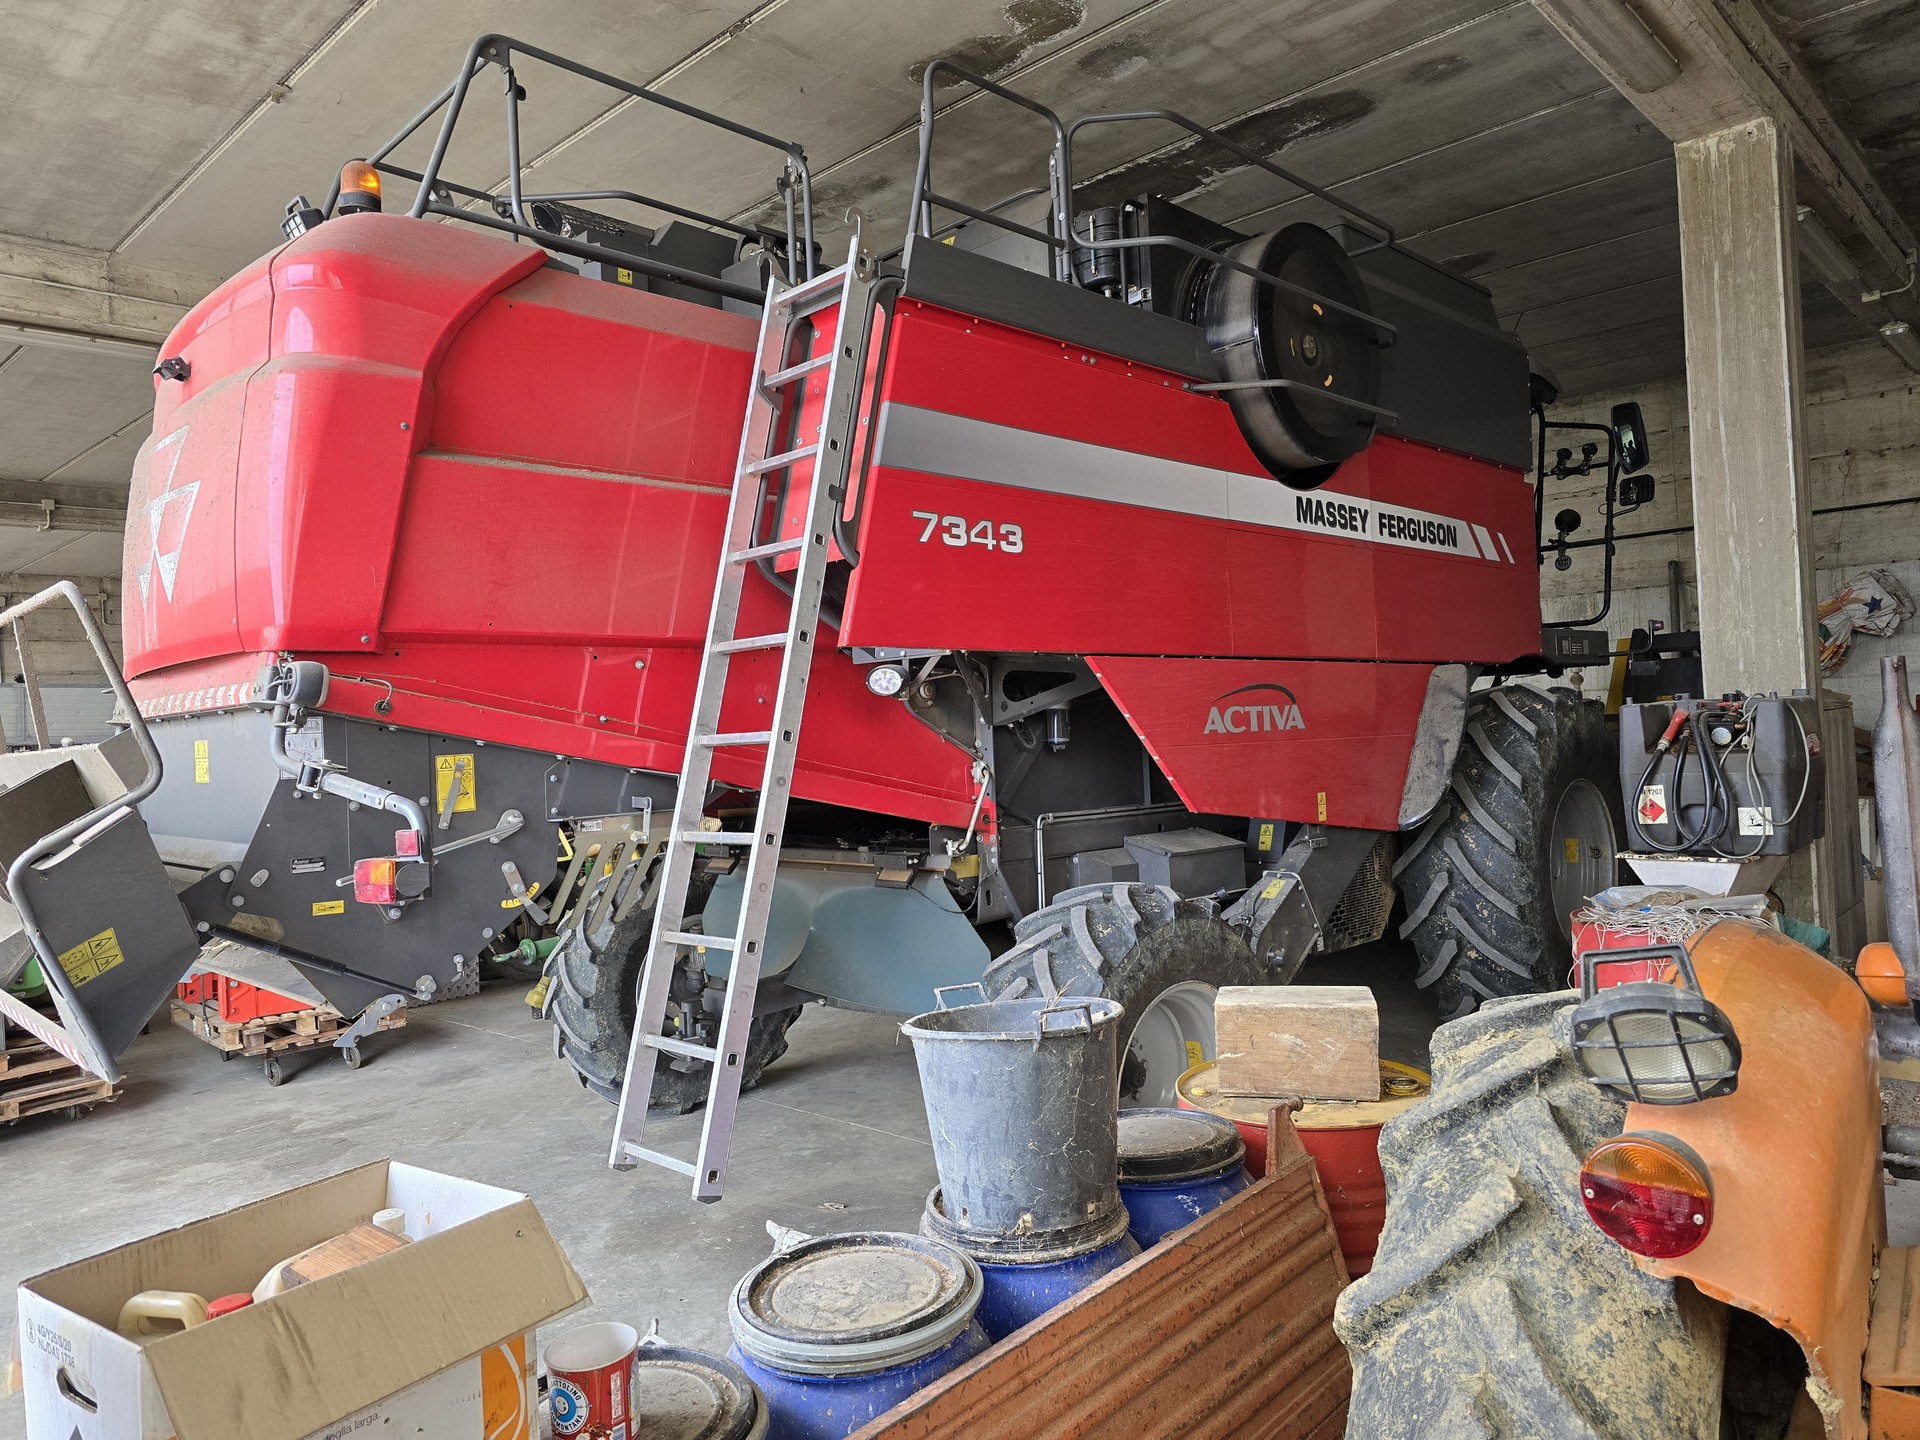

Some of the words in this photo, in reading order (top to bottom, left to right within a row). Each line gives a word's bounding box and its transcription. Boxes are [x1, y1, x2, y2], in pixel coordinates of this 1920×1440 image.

[912, 510, 1024, 554] 7343
[1296, 496, 1369, 533] MASSEY
[1378, 512, 1458, 548] FERGUSON
[1203, 704, 1306, 735] ACTIVA
[354, 1411, 381, 1430] larga.
